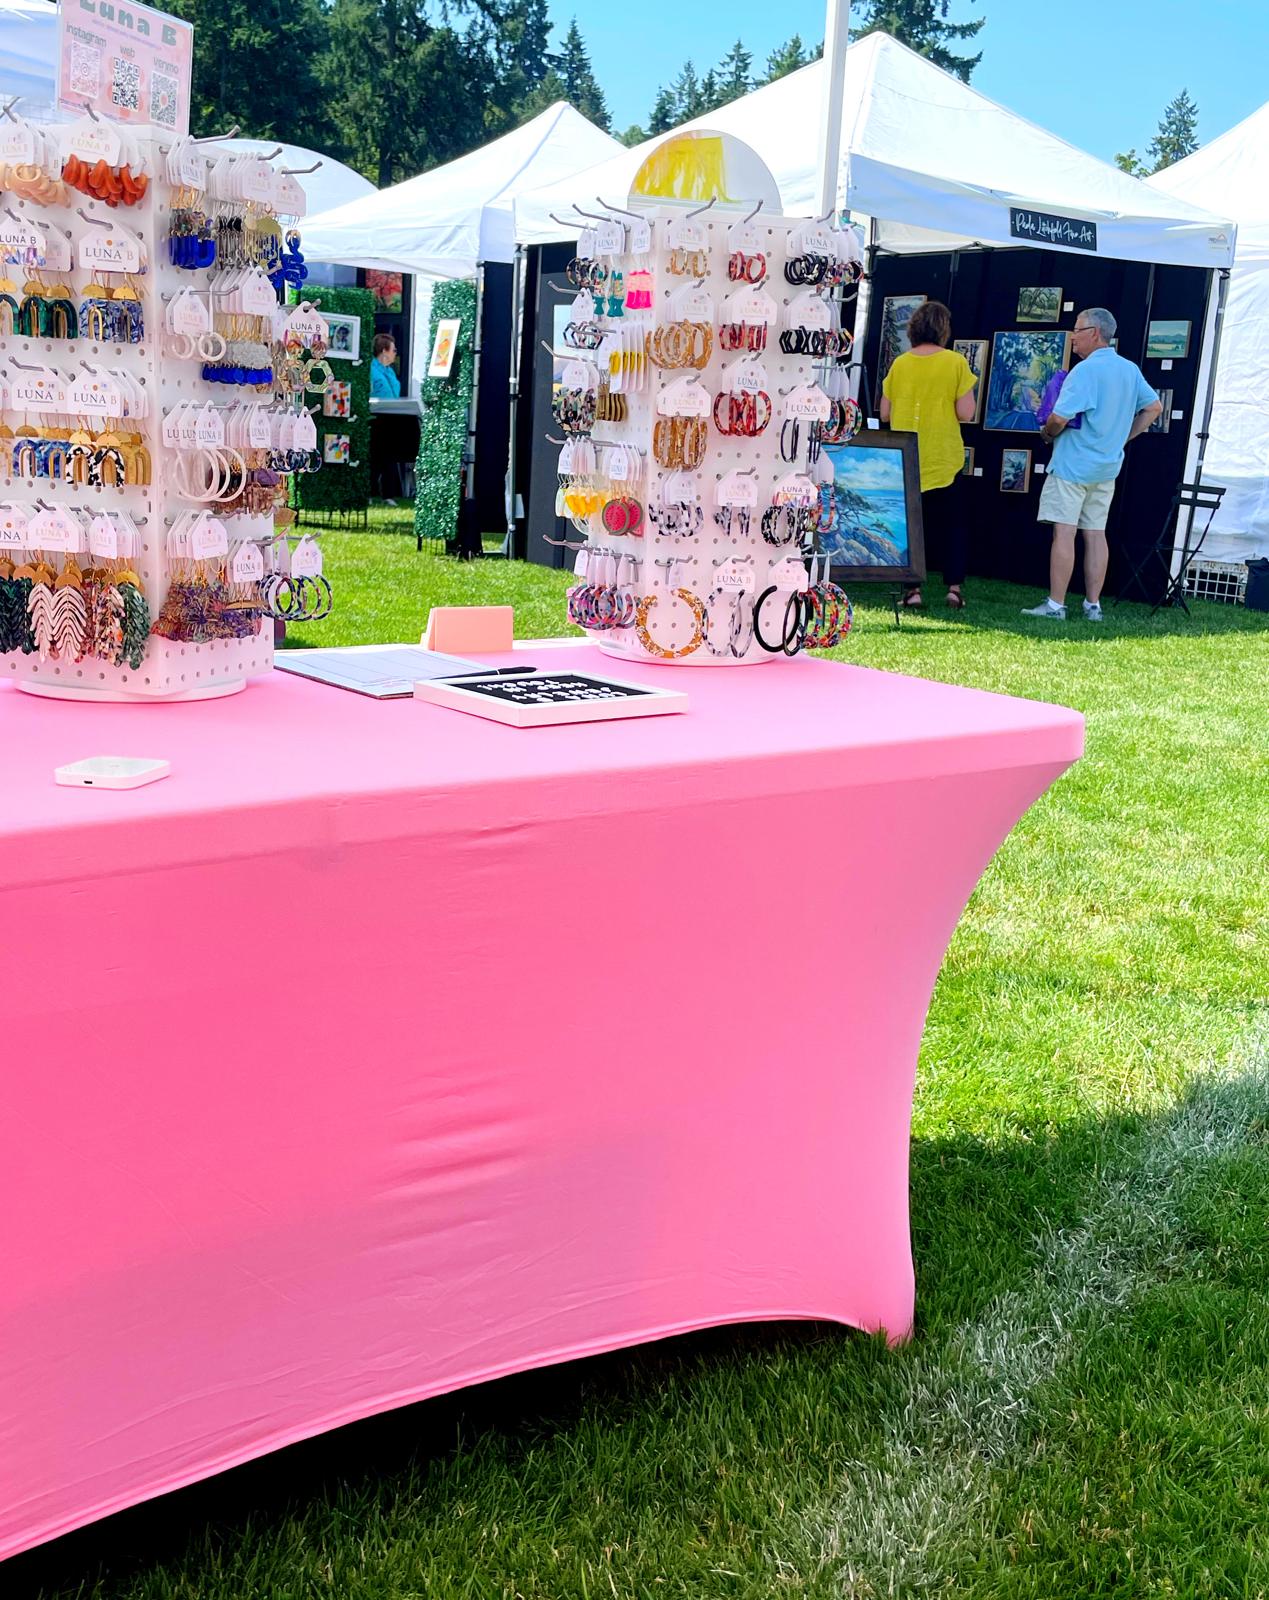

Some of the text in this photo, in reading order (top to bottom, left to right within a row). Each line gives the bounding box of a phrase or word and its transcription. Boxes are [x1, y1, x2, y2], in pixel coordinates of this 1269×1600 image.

[66, 24, 107, 48] instagram
[161, 24, 178, 46] B
[120, 46, 136, 58] web
[153, 57, 180, 75] venmo
[0, 234, 37, 245] LUNA B
[805, 236, 828, 247] LUNA
[85, 247, 122, 260] LUNA
[127, 250, 134, 261] B
[290, 322, 312, 331] LUNA
[737, 376, 758, 387] LUNA
[17, 388, 65, 402] LUNA B
[73, 391, 117, 405] LUNA B
[791, 401, 818, 413] LUNA
[198, 429, 215, 440] LUNA
[782, 485, 803, 494] LUNA
[236, 562, 256, 573] LUNA
[717, 575, 743, 584] LUNA
